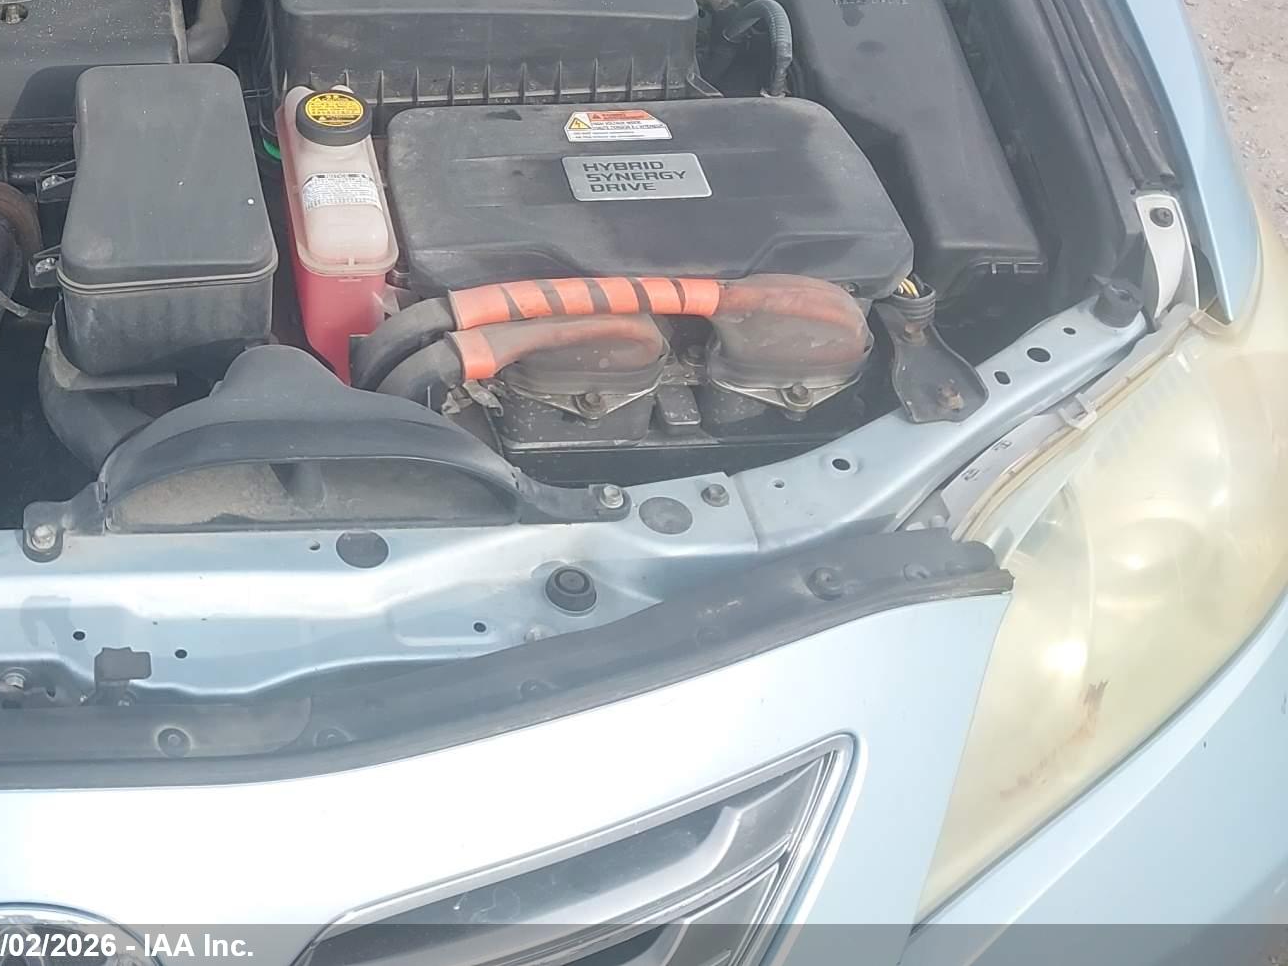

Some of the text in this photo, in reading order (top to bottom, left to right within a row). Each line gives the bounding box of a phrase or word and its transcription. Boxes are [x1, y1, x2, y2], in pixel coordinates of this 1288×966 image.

[582, 161, 663, 172] HYBRID
[586, 170, 686, 182] SYNERGY
[590, 182, 657, 193] DRIVE
